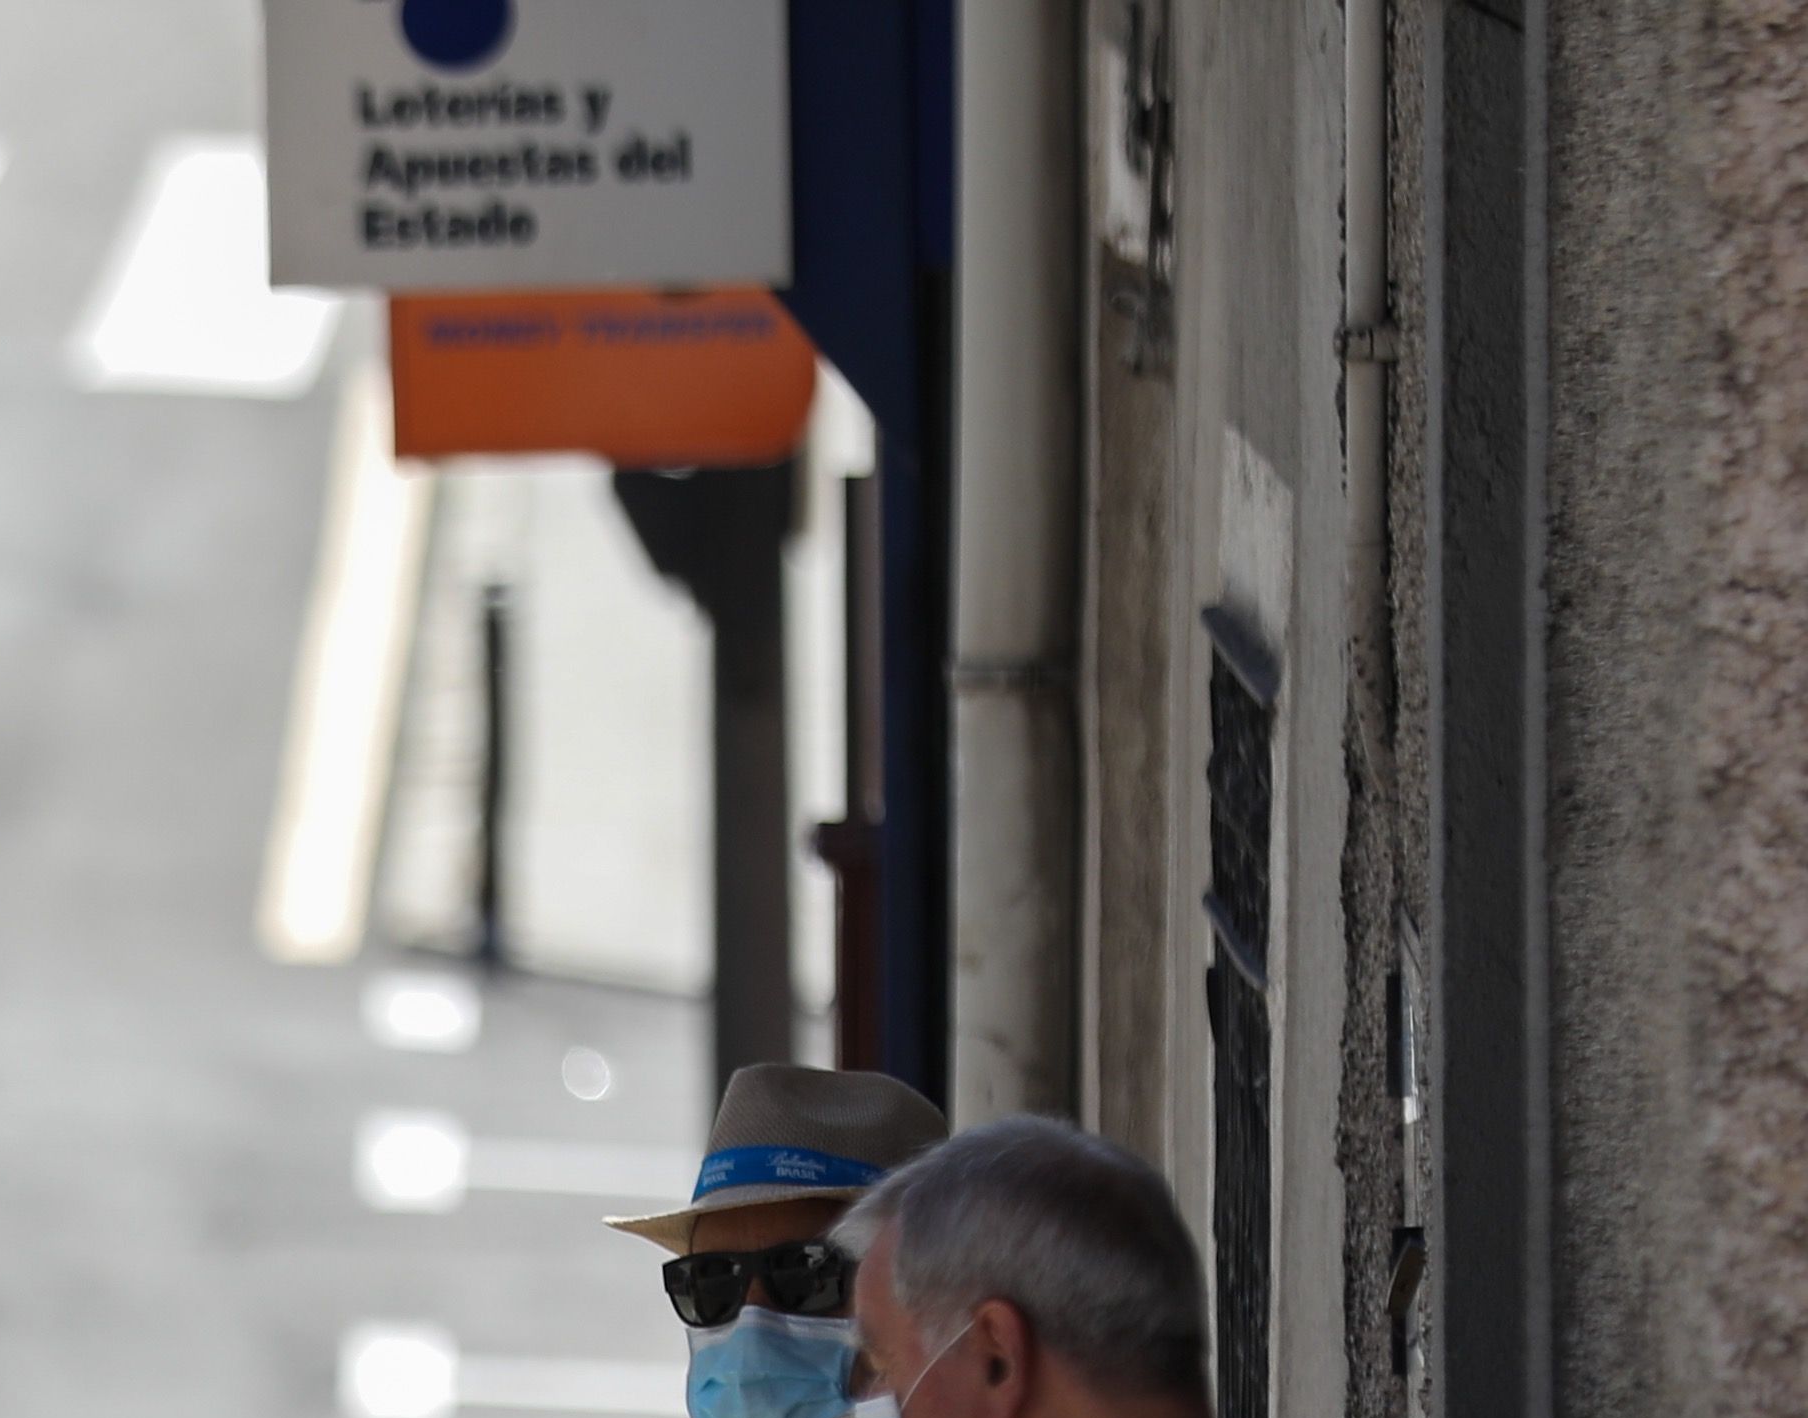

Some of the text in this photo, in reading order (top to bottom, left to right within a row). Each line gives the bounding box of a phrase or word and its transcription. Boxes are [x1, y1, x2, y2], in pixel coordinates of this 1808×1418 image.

[358, 83, 612, 133] Loterías y
[365, 133, 693, 195] Apuestas del
[361, 201, 538, 247] Estado
